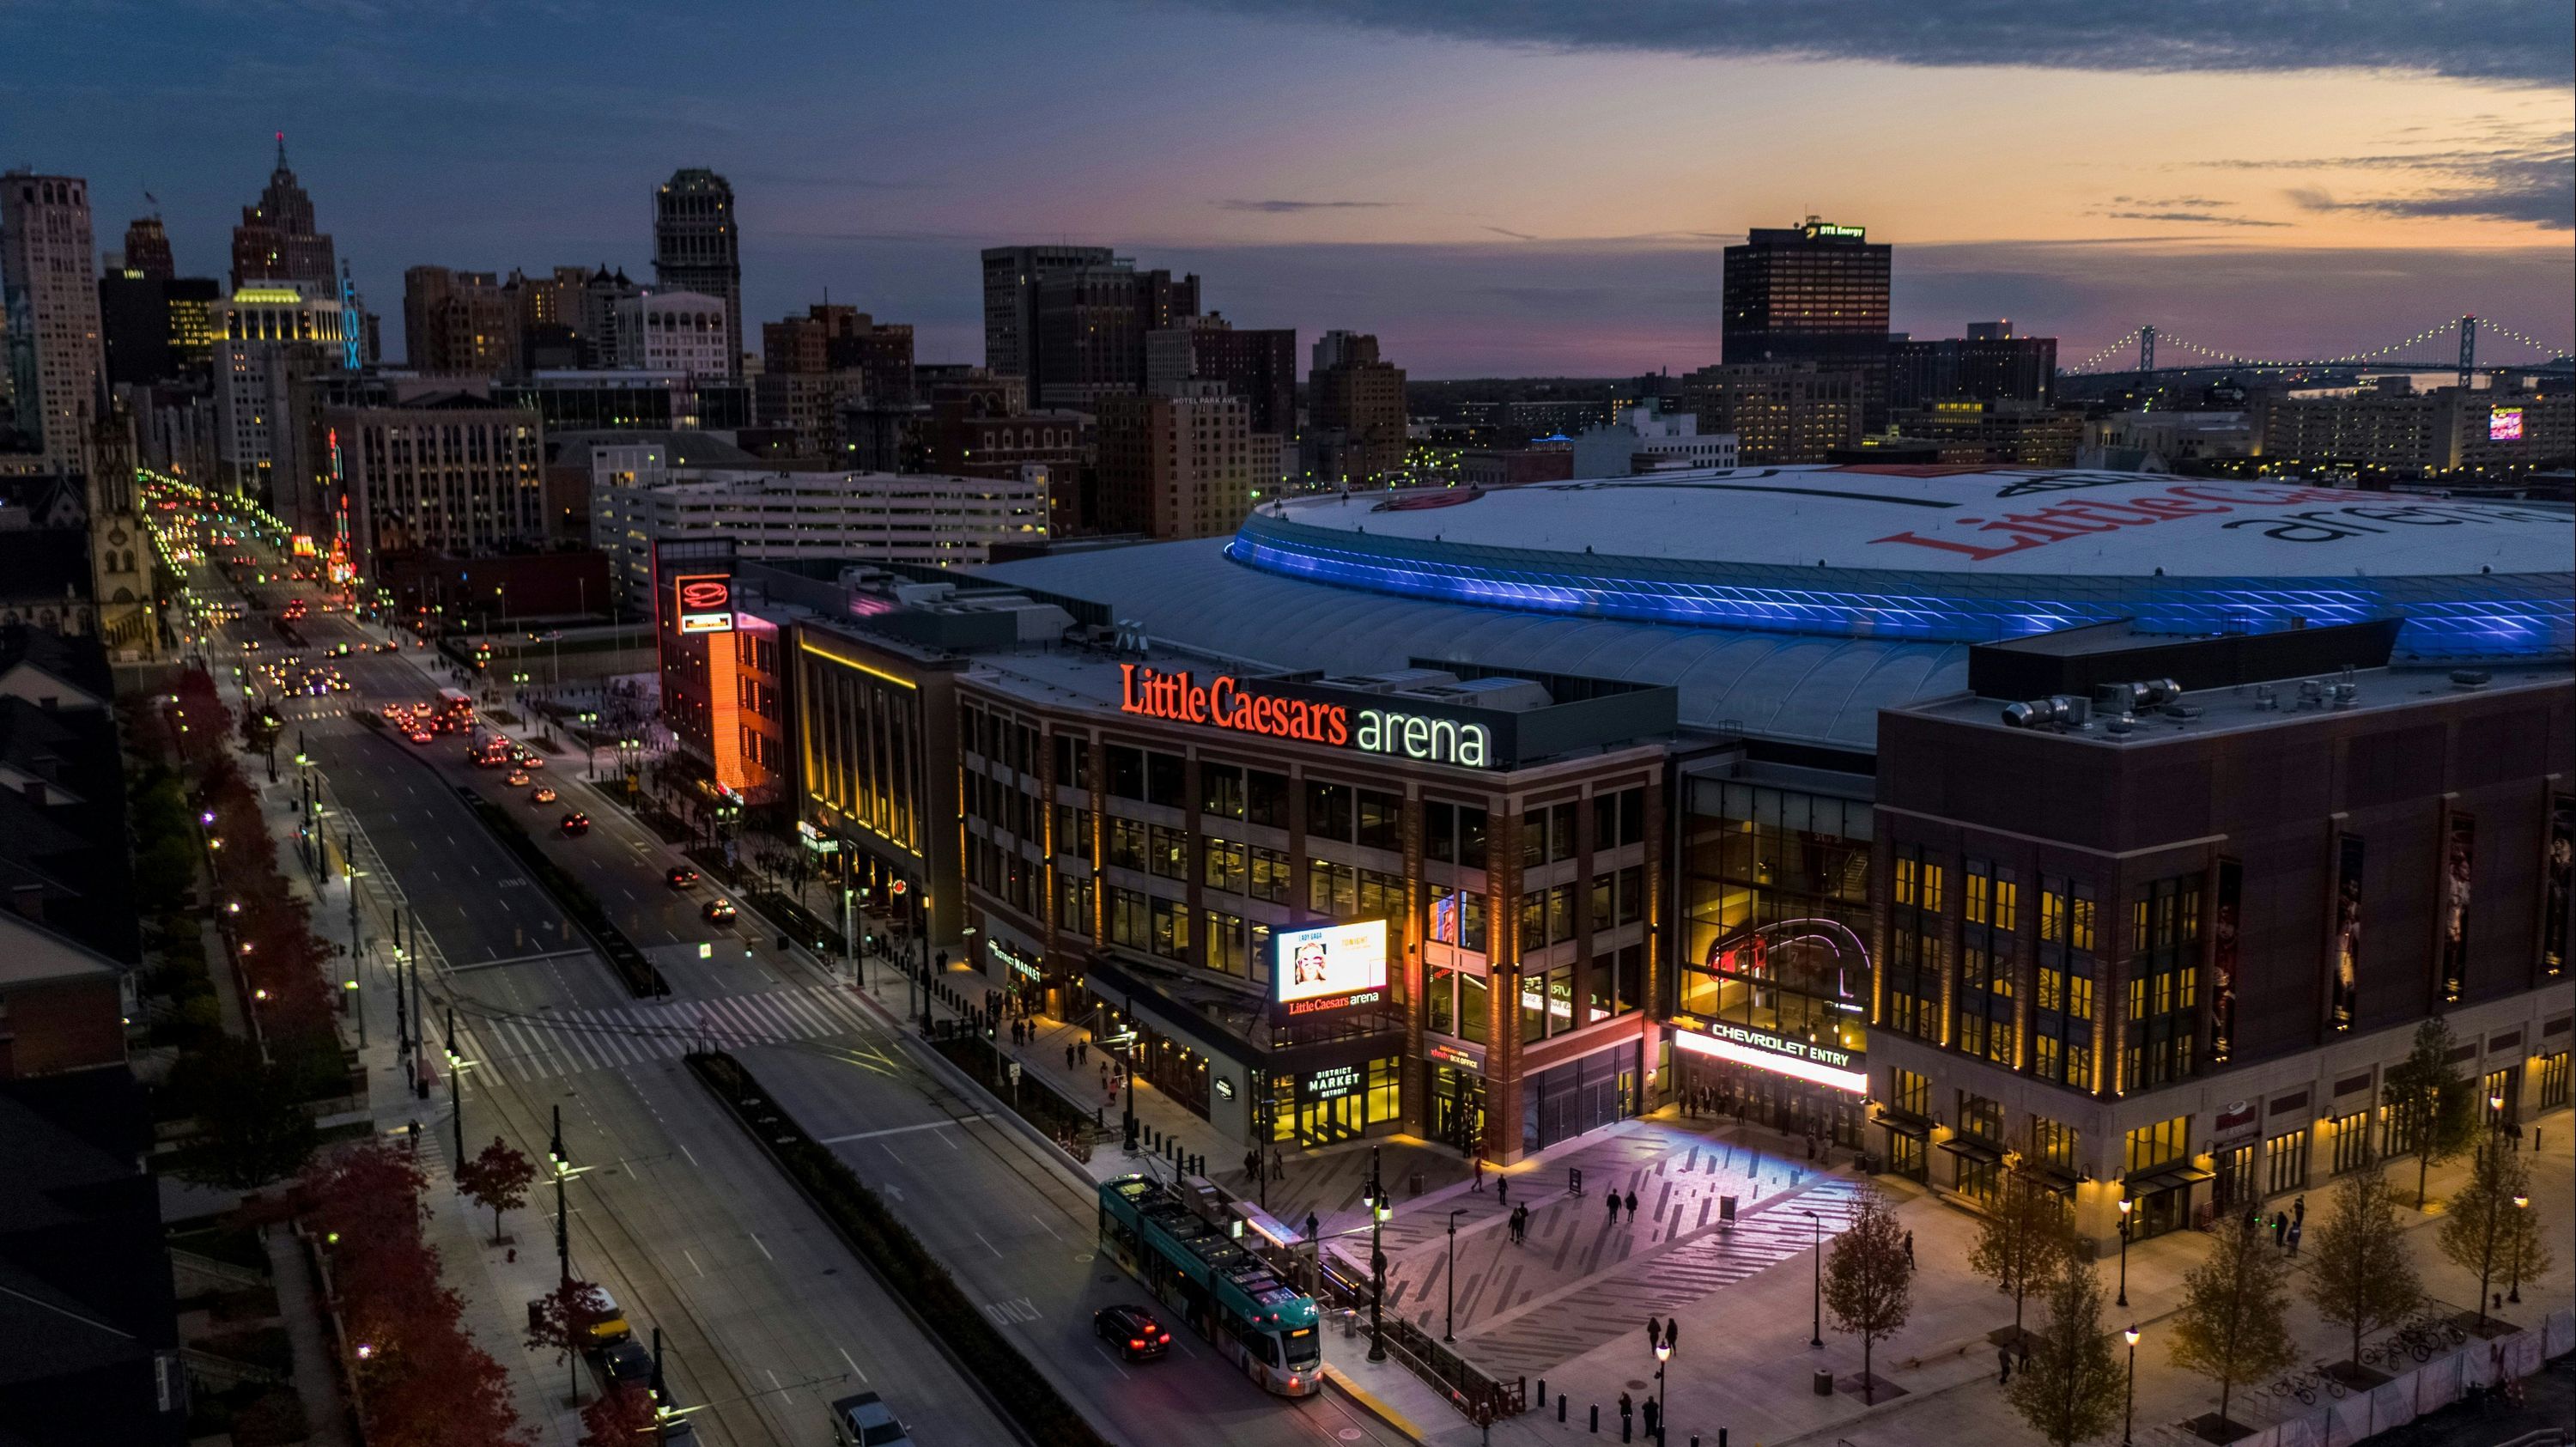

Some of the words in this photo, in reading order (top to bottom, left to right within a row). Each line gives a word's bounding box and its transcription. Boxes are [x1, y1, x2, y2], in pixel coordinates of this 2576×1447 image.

[1820, 226, 1836, 234] DTE
[1837, 227, 1863, 237] Energy
[344, 279, 361, 370] FOX
[1866, 497, 2234, 561] Little
[1120, 662, 1206, 724] Little
[1210, 676, 1348, 745] Caesars
[1357, 709, 1485, 768] arena
[994, 948, 1014, 966] DISTRICT
[1014, 958, 1041, 982] MARKET
[1289, 1000, 1314, 1015] Little
[1314, 996, 1349, 1011] Caesars
[1350, 992, 1379, 1006] arena
[1712, 1023, 1807, 1056] CHEVROLET
[1809, 1047, 1849, 1067] ENTRY
[1316, 1066, 1352, 1079] DISTRICT
[1450, 1055, 1460, 1063] BOX
[1460, 1057, 1478, 1068] OFFICE
[1309, 1073, 1360, 1091] MARKET
[1321, 1087, 1347, 1097] DETROIT
[985, 1297, 1042, 1325] ONLY
